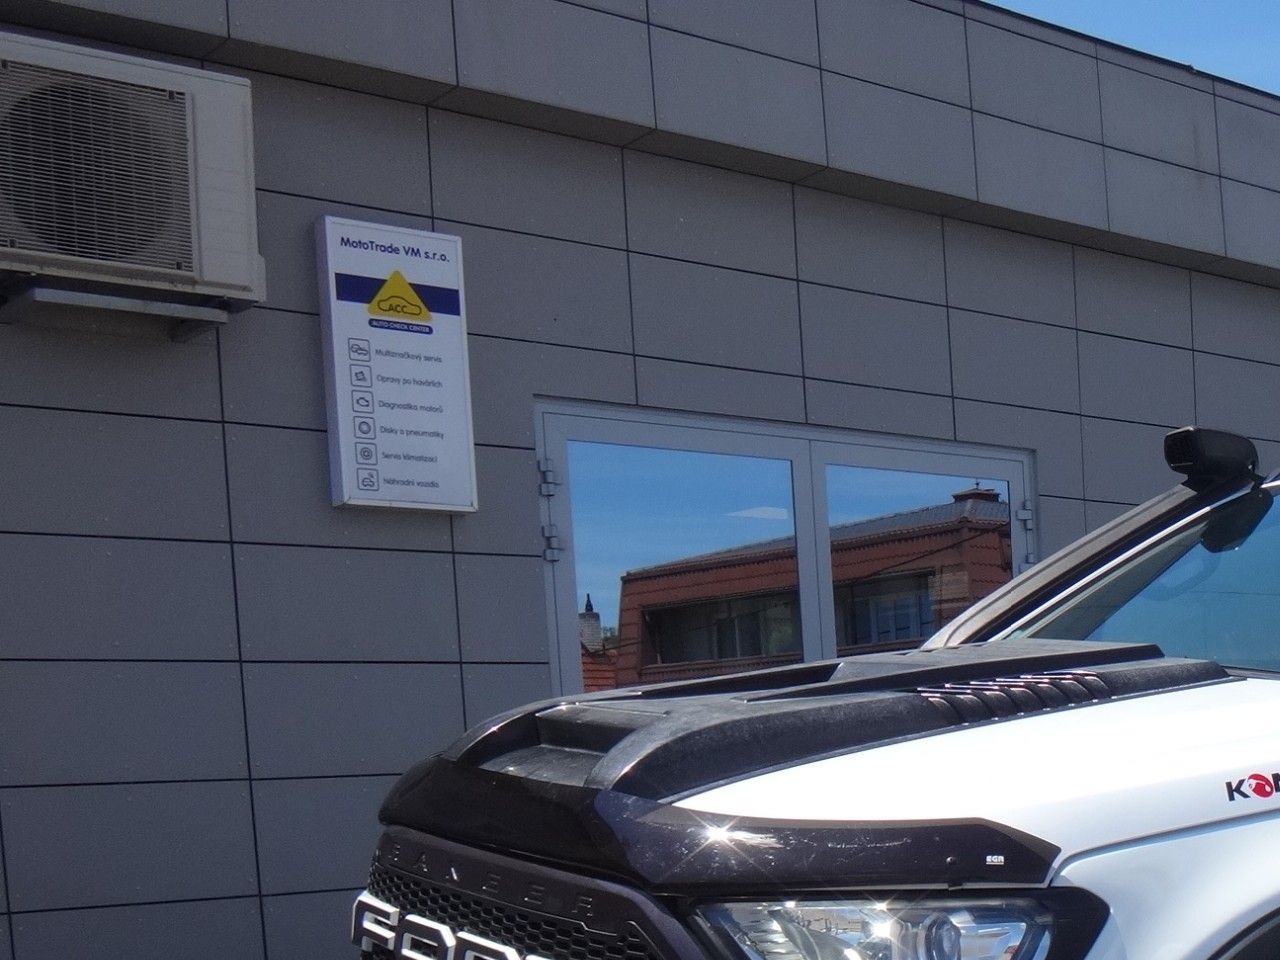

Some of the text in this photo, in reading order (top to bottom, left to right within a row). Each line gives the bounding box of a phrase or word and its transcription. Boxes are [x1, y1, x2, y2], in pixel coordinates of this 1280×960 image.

[340, 237, 450, 262] MotoTrade VM s.r.o.
[388, 303, 408, 313] ACC
[423, 355, 442, 363] servis
[380, 425, 398, 435] Disky
